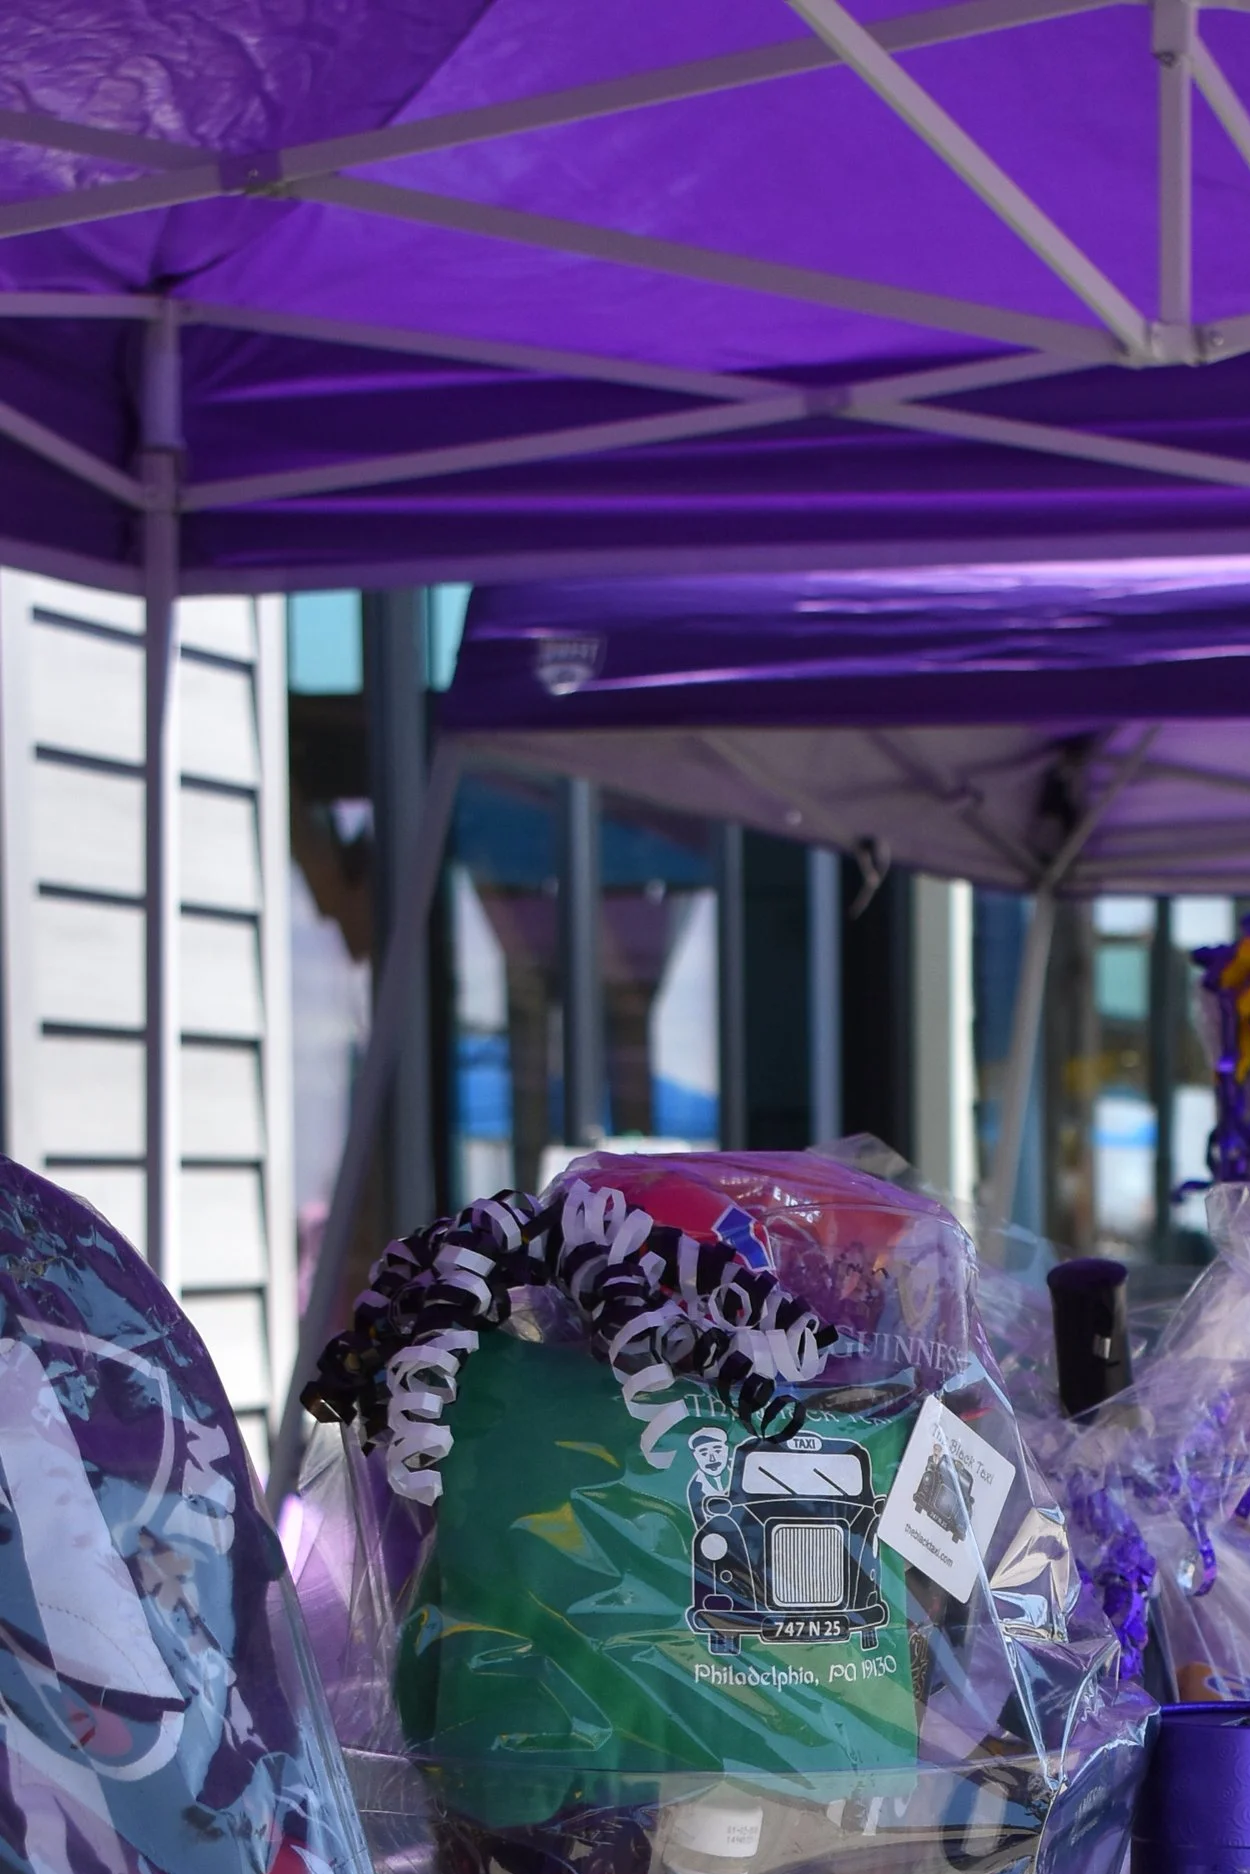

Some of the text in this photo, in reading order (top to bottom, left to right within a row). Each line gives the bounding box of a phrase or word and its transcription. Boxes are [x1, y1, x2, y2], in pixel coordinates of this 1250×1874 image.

[684, 1394, 741, 1424] Th
[793, 1438, 817, 1449] TAXI
[950, 1440, 976, 1469] Black
[976, 1461, 994, 1486] Taxi
[905, 1523, 954, 1568] theblacktaxi.com
[775, 1620, 841, 1637] 747 N 25
[694, 1655, 897, 1692] Philadelphia, PA 19130
